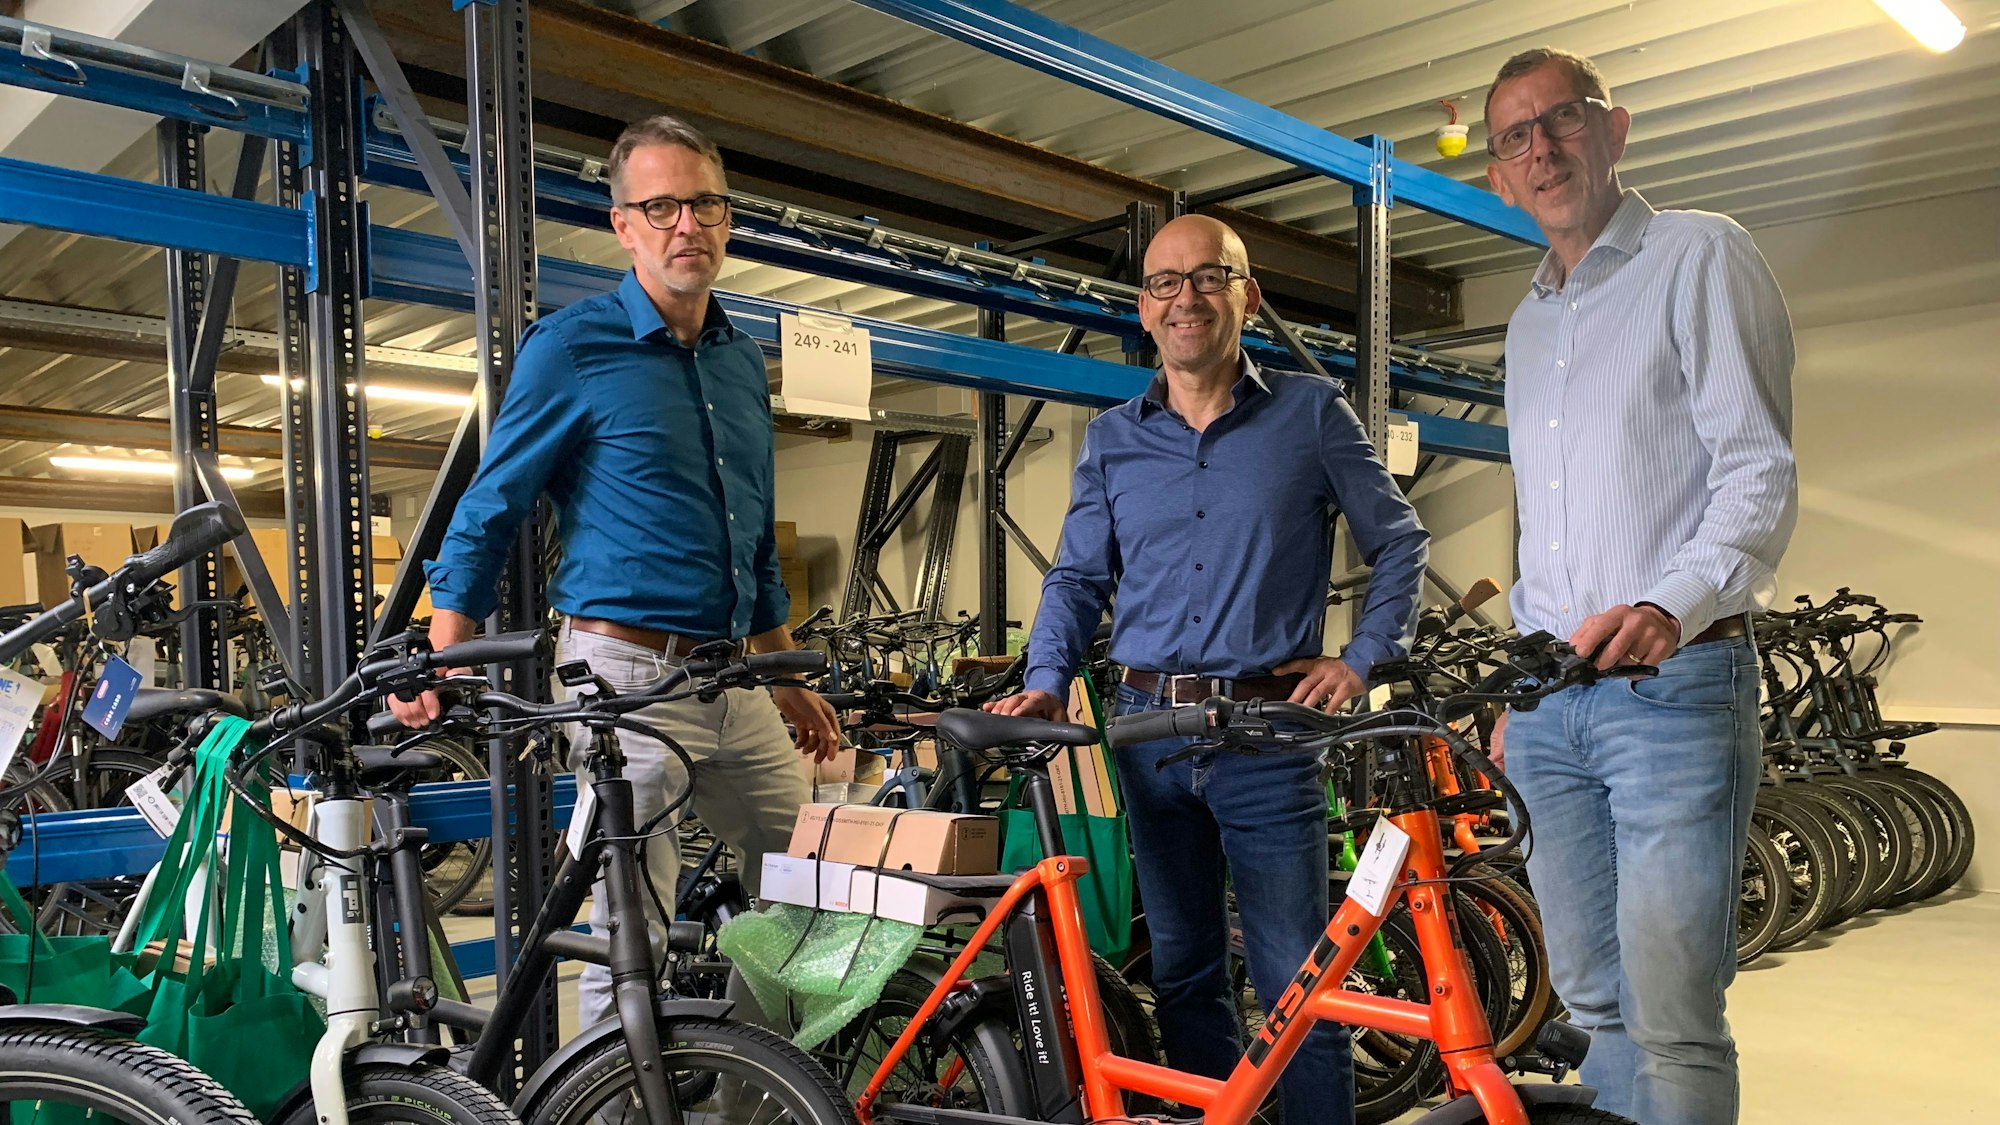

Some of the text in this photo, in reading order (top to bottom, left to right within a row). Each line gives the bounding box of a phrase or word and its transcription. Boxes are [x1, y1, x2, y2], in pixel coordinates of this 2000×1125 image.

[794, 332, 821, 349] 249
[833, 340, 857, 356] 241
[1400, 431, 1413, 442] 232
[1022, 970, 1049, 1064] Ride it! Love it!
[549, 1066, 611, 1122] SCHWALBE
[404, 1097, 452, 1120] PICK-UP
